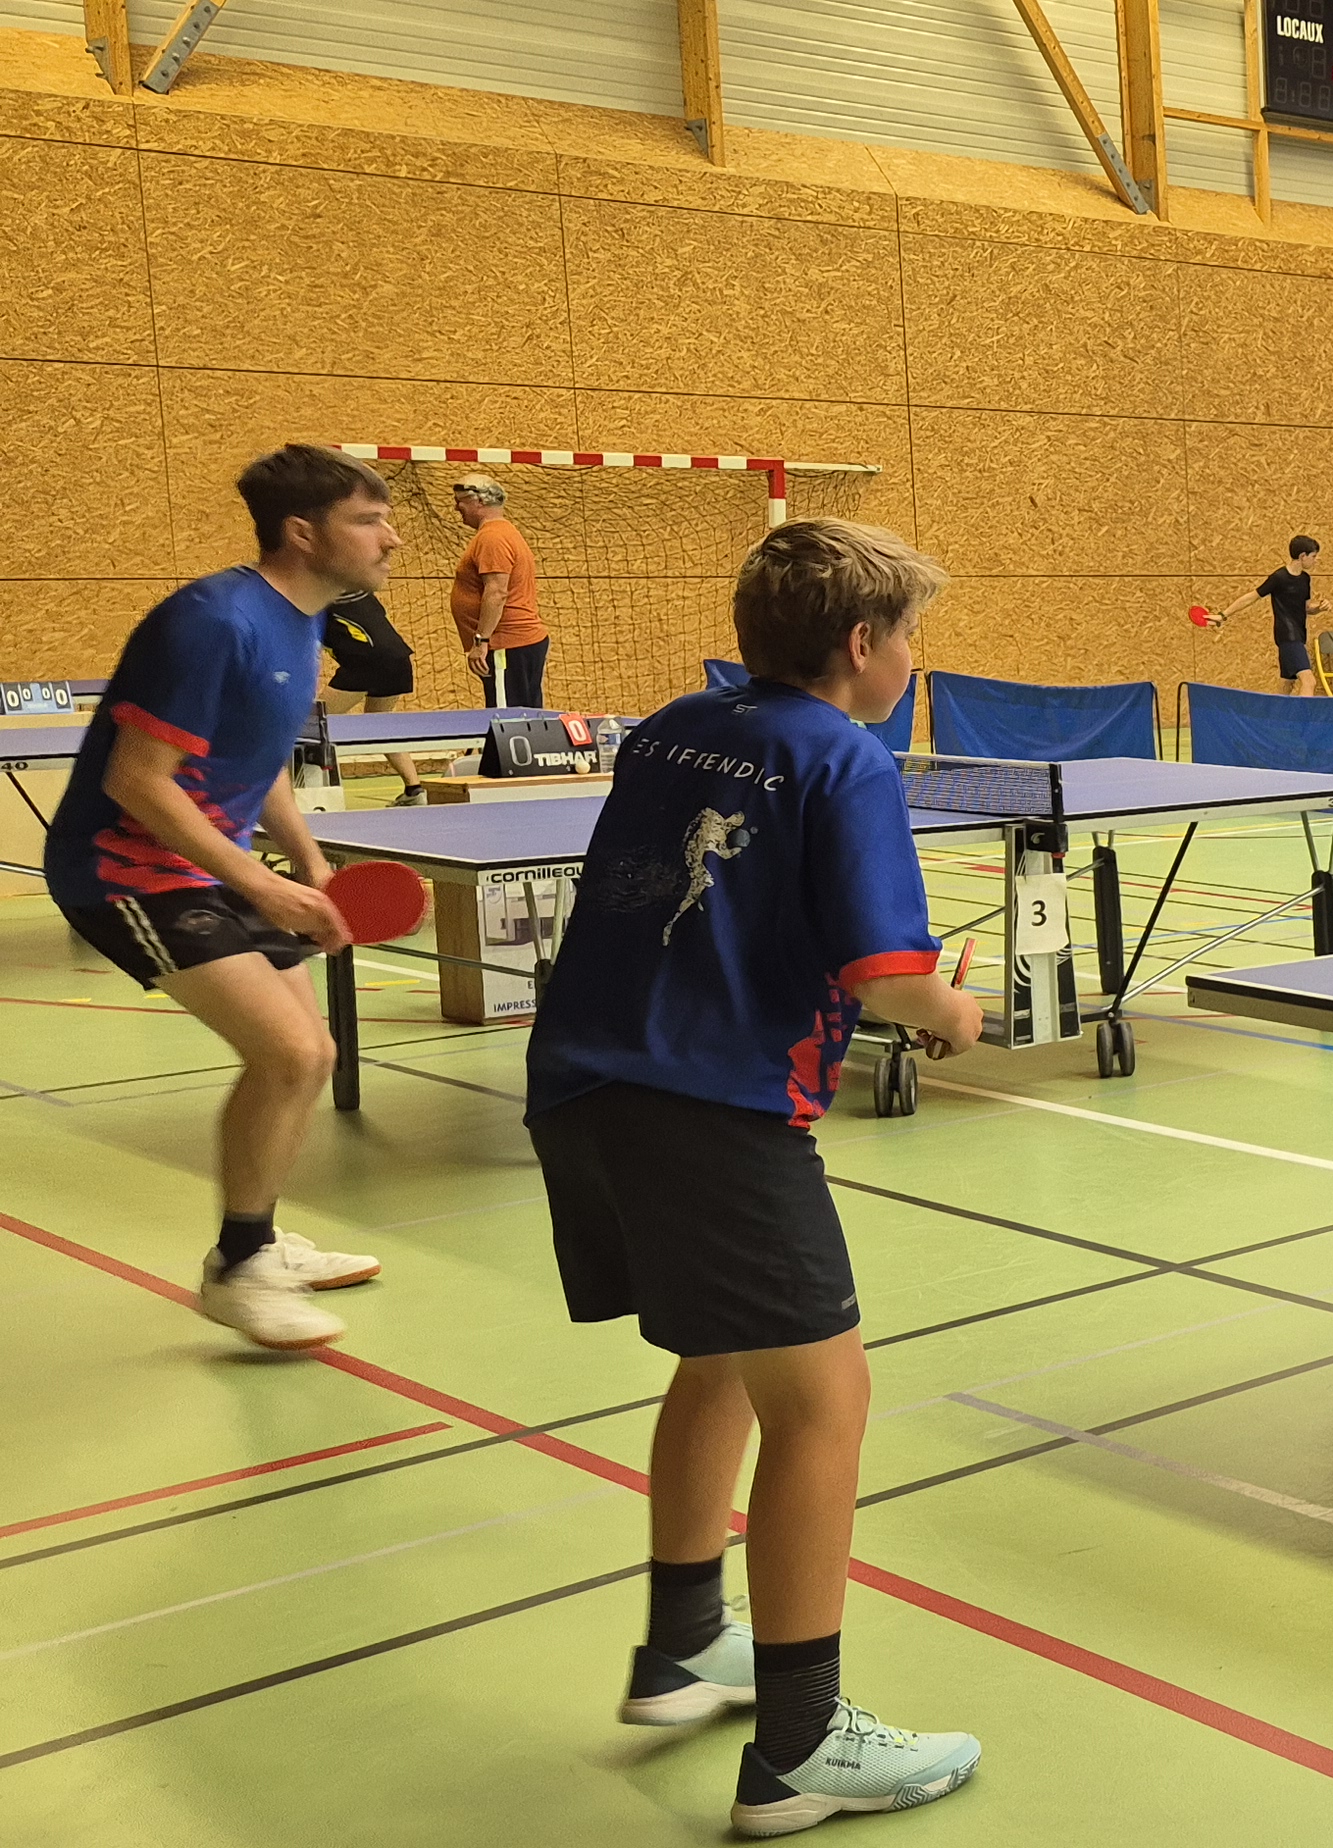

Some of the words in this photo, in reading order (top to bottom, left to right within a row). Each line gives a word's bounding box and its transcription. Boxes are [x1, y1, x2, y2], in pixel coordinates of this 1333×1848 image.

[1276, 15, 1324, 44] LOCAUX
[6, 690, 20, 708] 0
[55, 689, 69, 706] 0
[568, 720, 588, 742] 0
[533, 750, 598, 767] TIBHAR
[666, 744, 785, 792] IFFENDIC
[1031, 899, 1048, 927] 3
